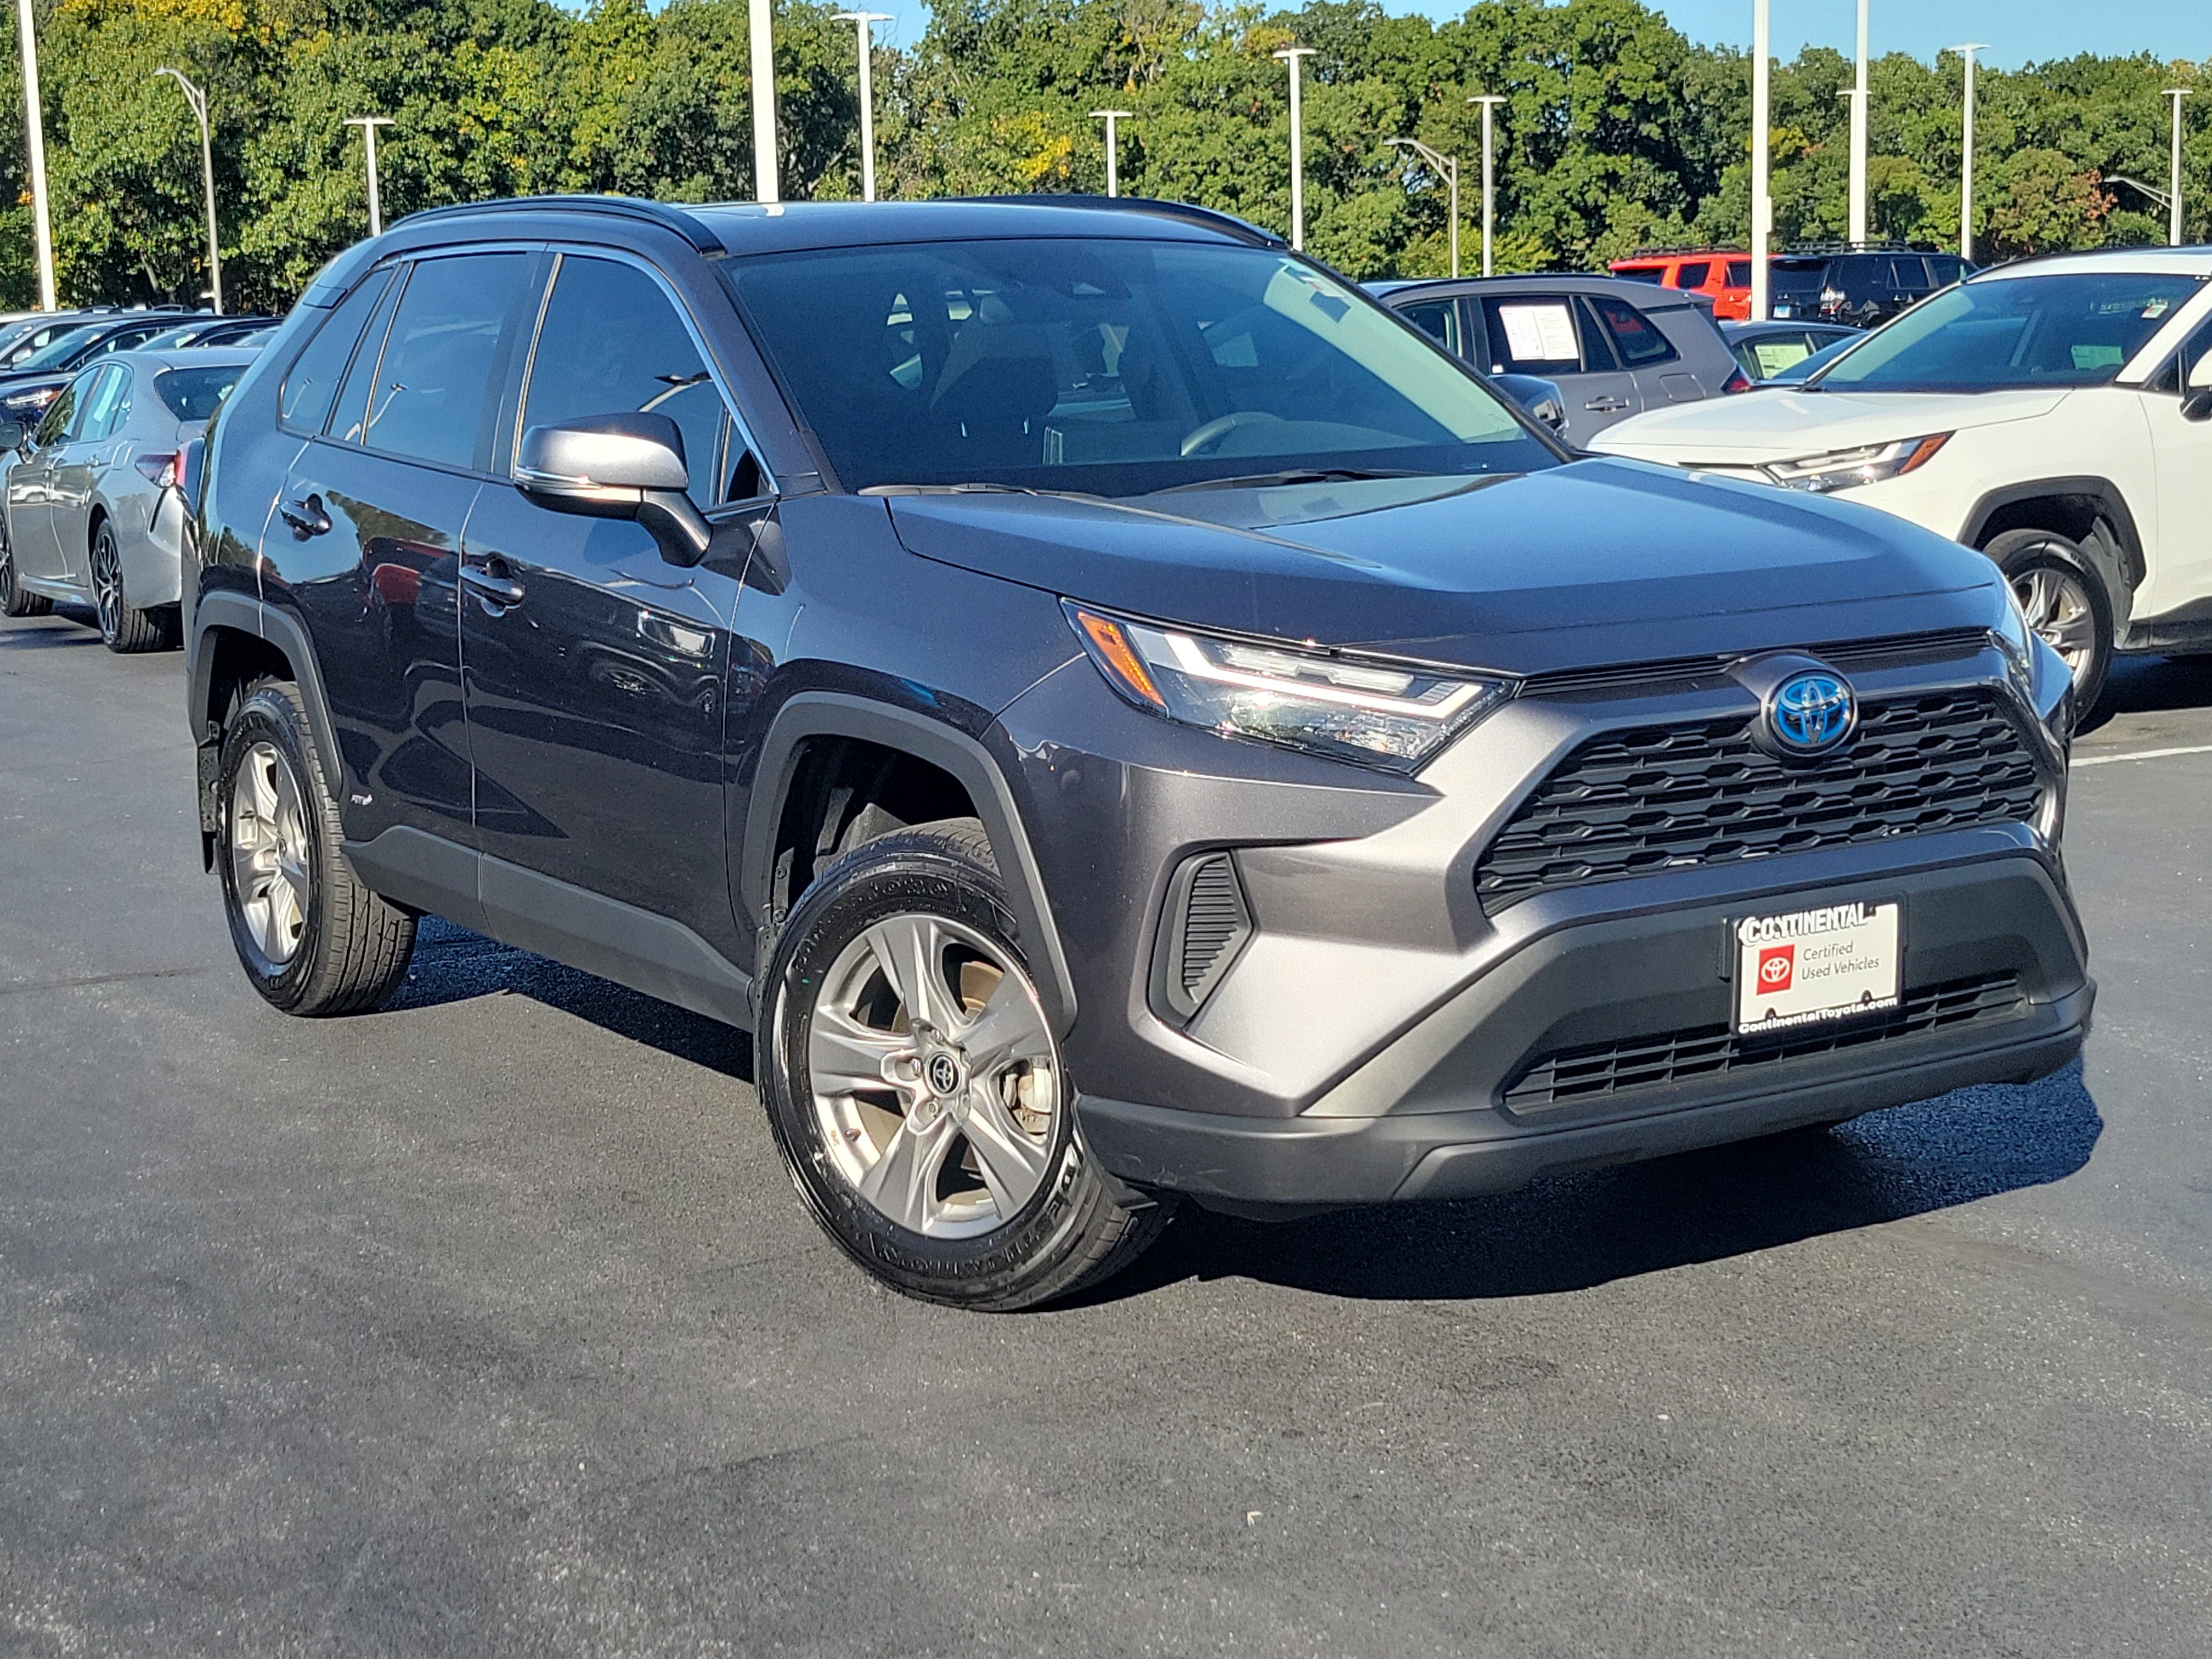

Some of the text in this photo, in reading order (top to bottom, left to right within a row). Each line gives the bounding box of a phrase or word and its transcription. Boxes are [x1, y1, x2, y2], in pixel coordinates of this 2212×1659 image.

[1743, 902, 1866, 944] CONTINENTAL
[1803, 939, 1854, 961] Certified
[1802, 956, 1880, 980] Used Vehicles
[1738, 997, 1898, 1034] ContinentalToyota.com
